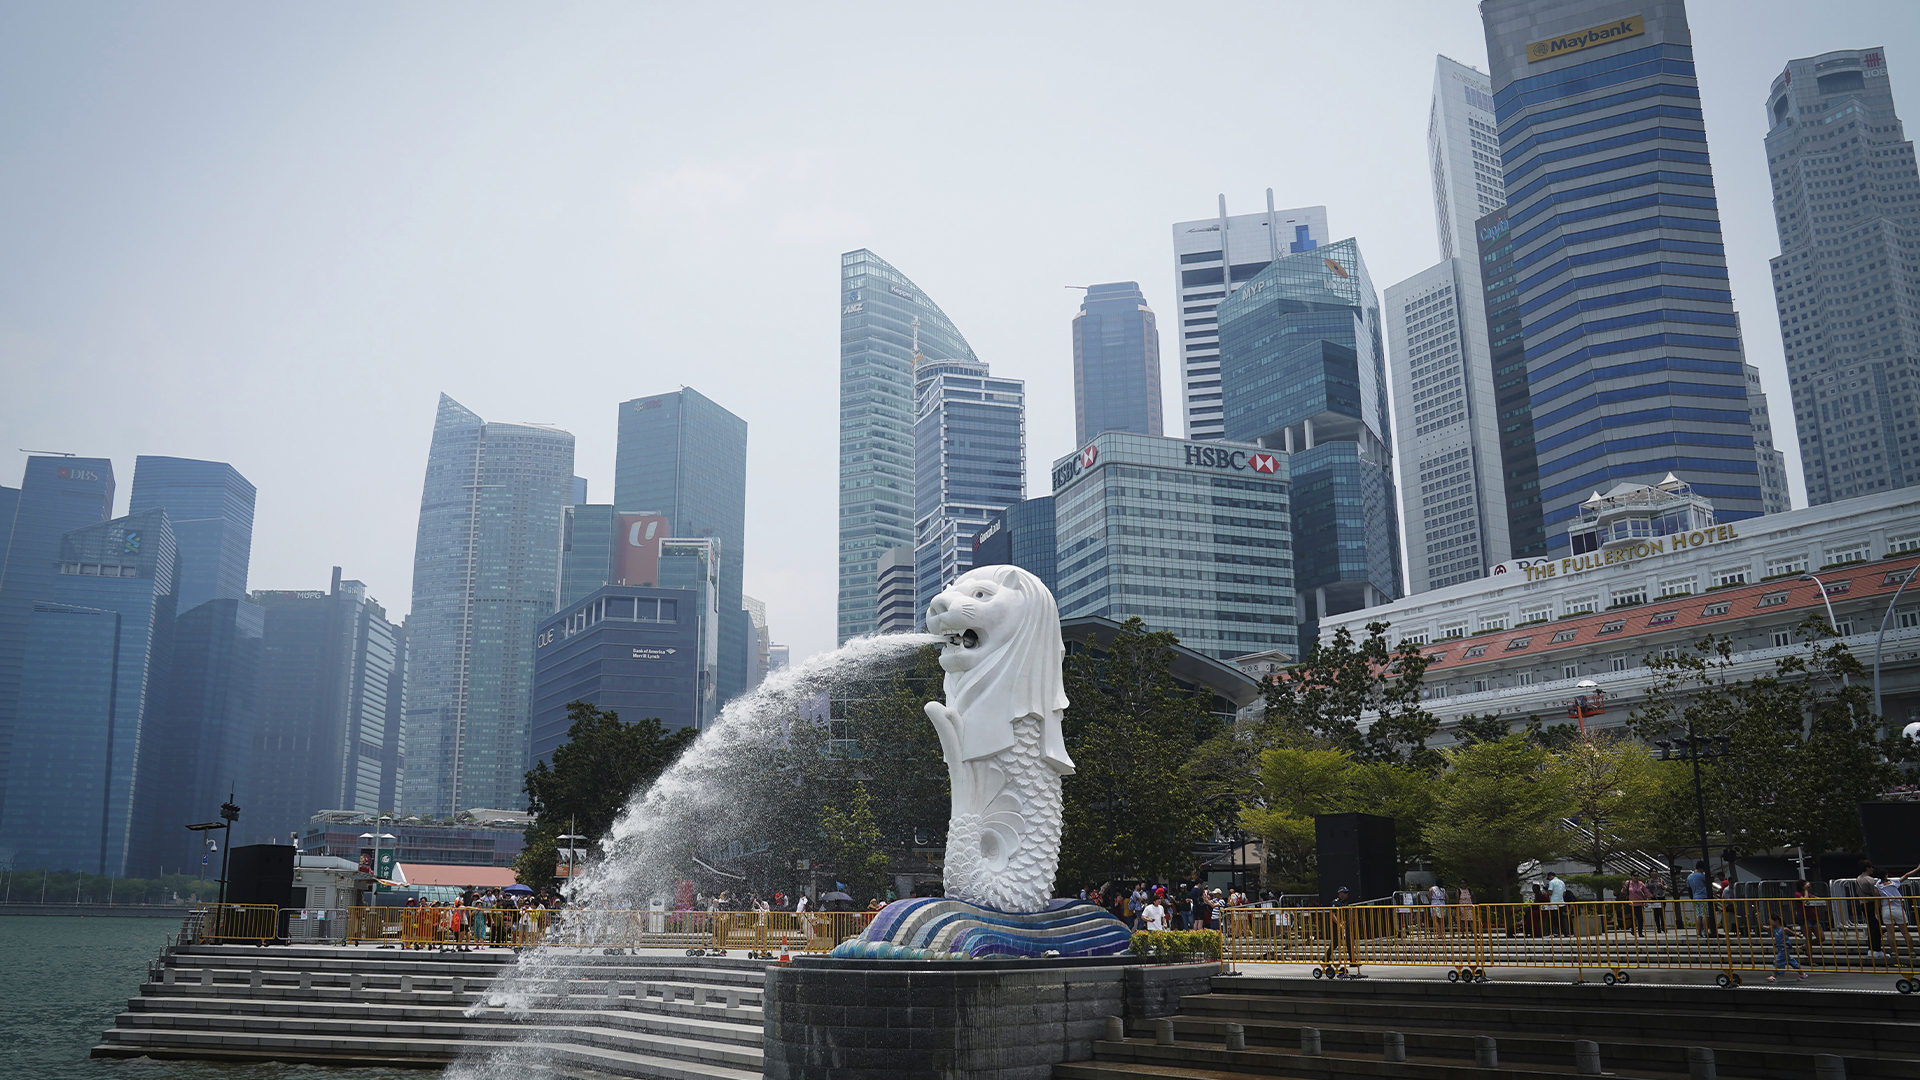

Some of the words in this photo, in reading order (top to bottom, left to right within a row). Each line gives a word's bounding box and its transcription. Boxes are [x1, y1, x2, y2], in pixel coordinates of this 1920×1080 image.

[1551, 22, 1633, 52] Maybank
[1863, 68, 1887, 78] UOB
[891, 285, 912, 299] Keppel
[1243, 281, 1265, 300] MYP
[1324, 279, 1353, 292] MYP
[843, 303, 863, 315] ANZ
[1184, 445, 1246, 470] HSBC
[70, 469, 98, 481] DBS
[1052, 454, 1082, 491] HSBC
[1525, 563, 1555, 581] THE
[1562, 540, 1663, 573] FULLERTON
[1672, 524, 1738, 550] HOTEL
[537, 628, 554, 648] OUE
